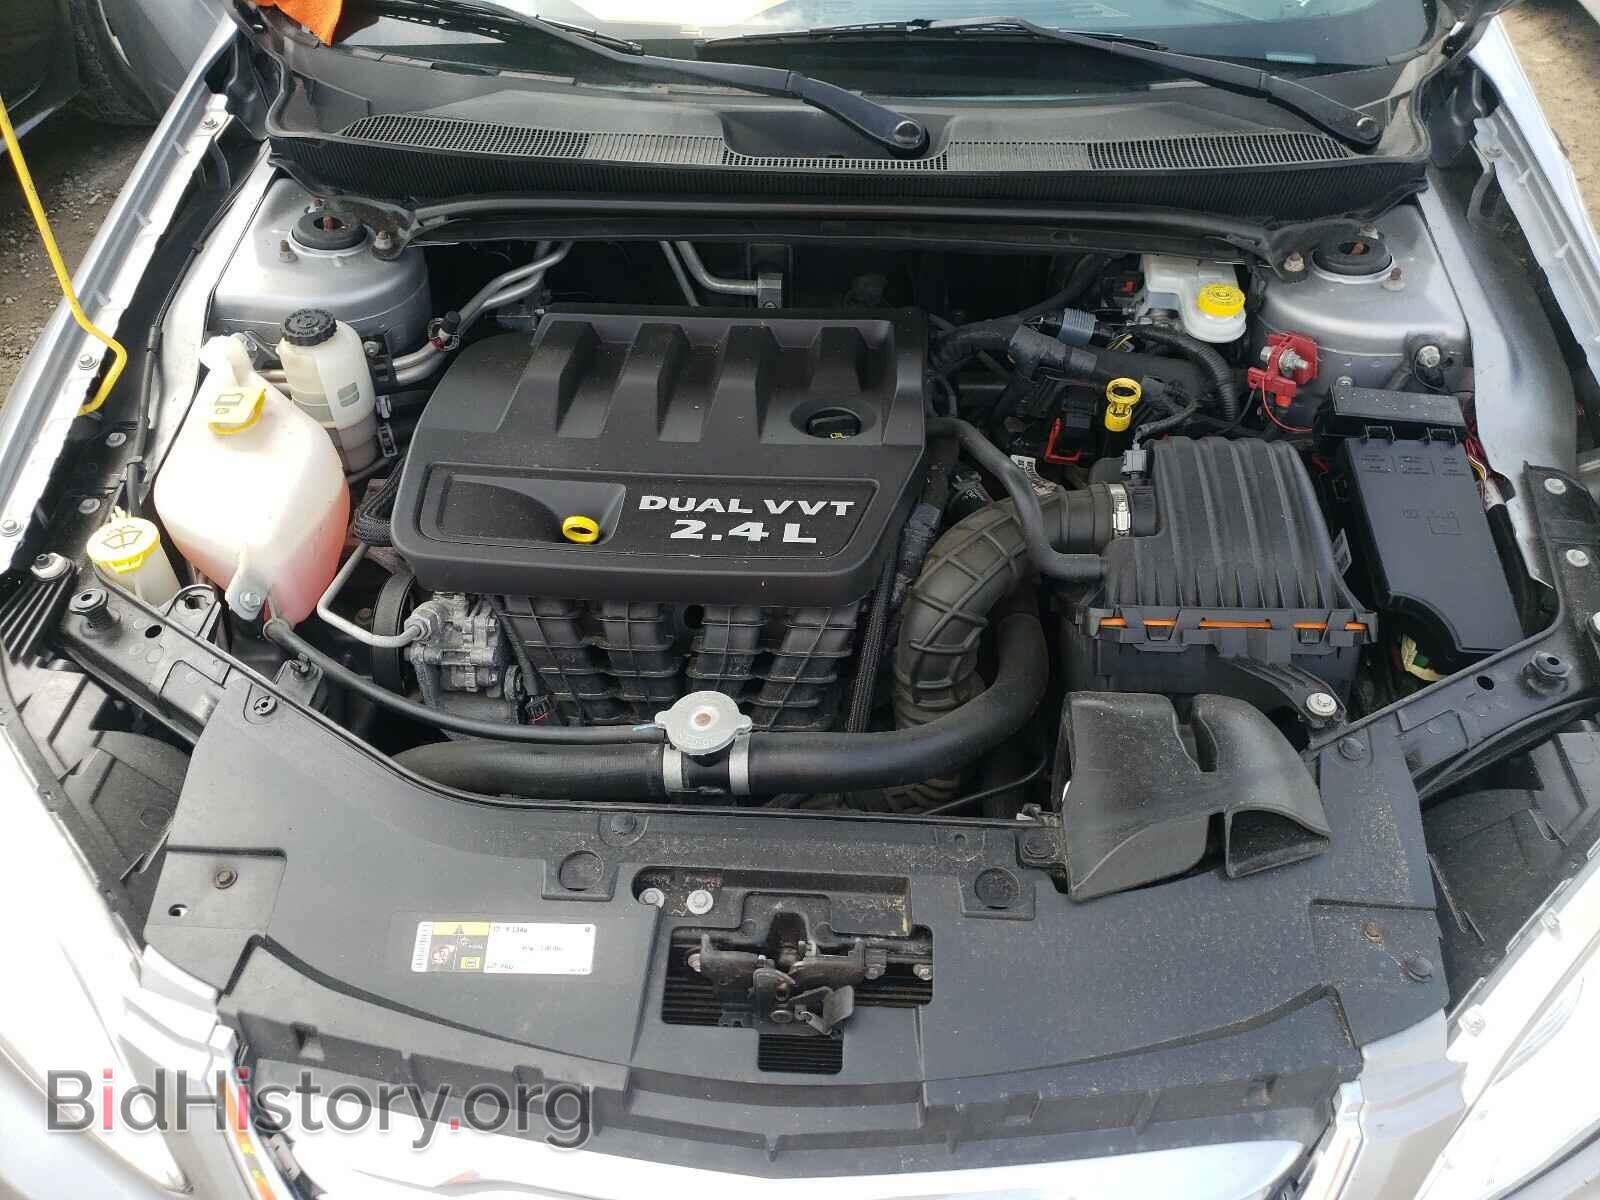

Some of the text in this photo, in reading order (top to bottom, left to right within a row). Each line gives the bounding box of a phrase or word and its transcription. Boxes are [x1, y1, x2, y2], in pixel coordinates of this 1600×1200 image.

[638, 495, 855, 516] DUAL VVT
[670, 519, 817, 544] 2.4 L
